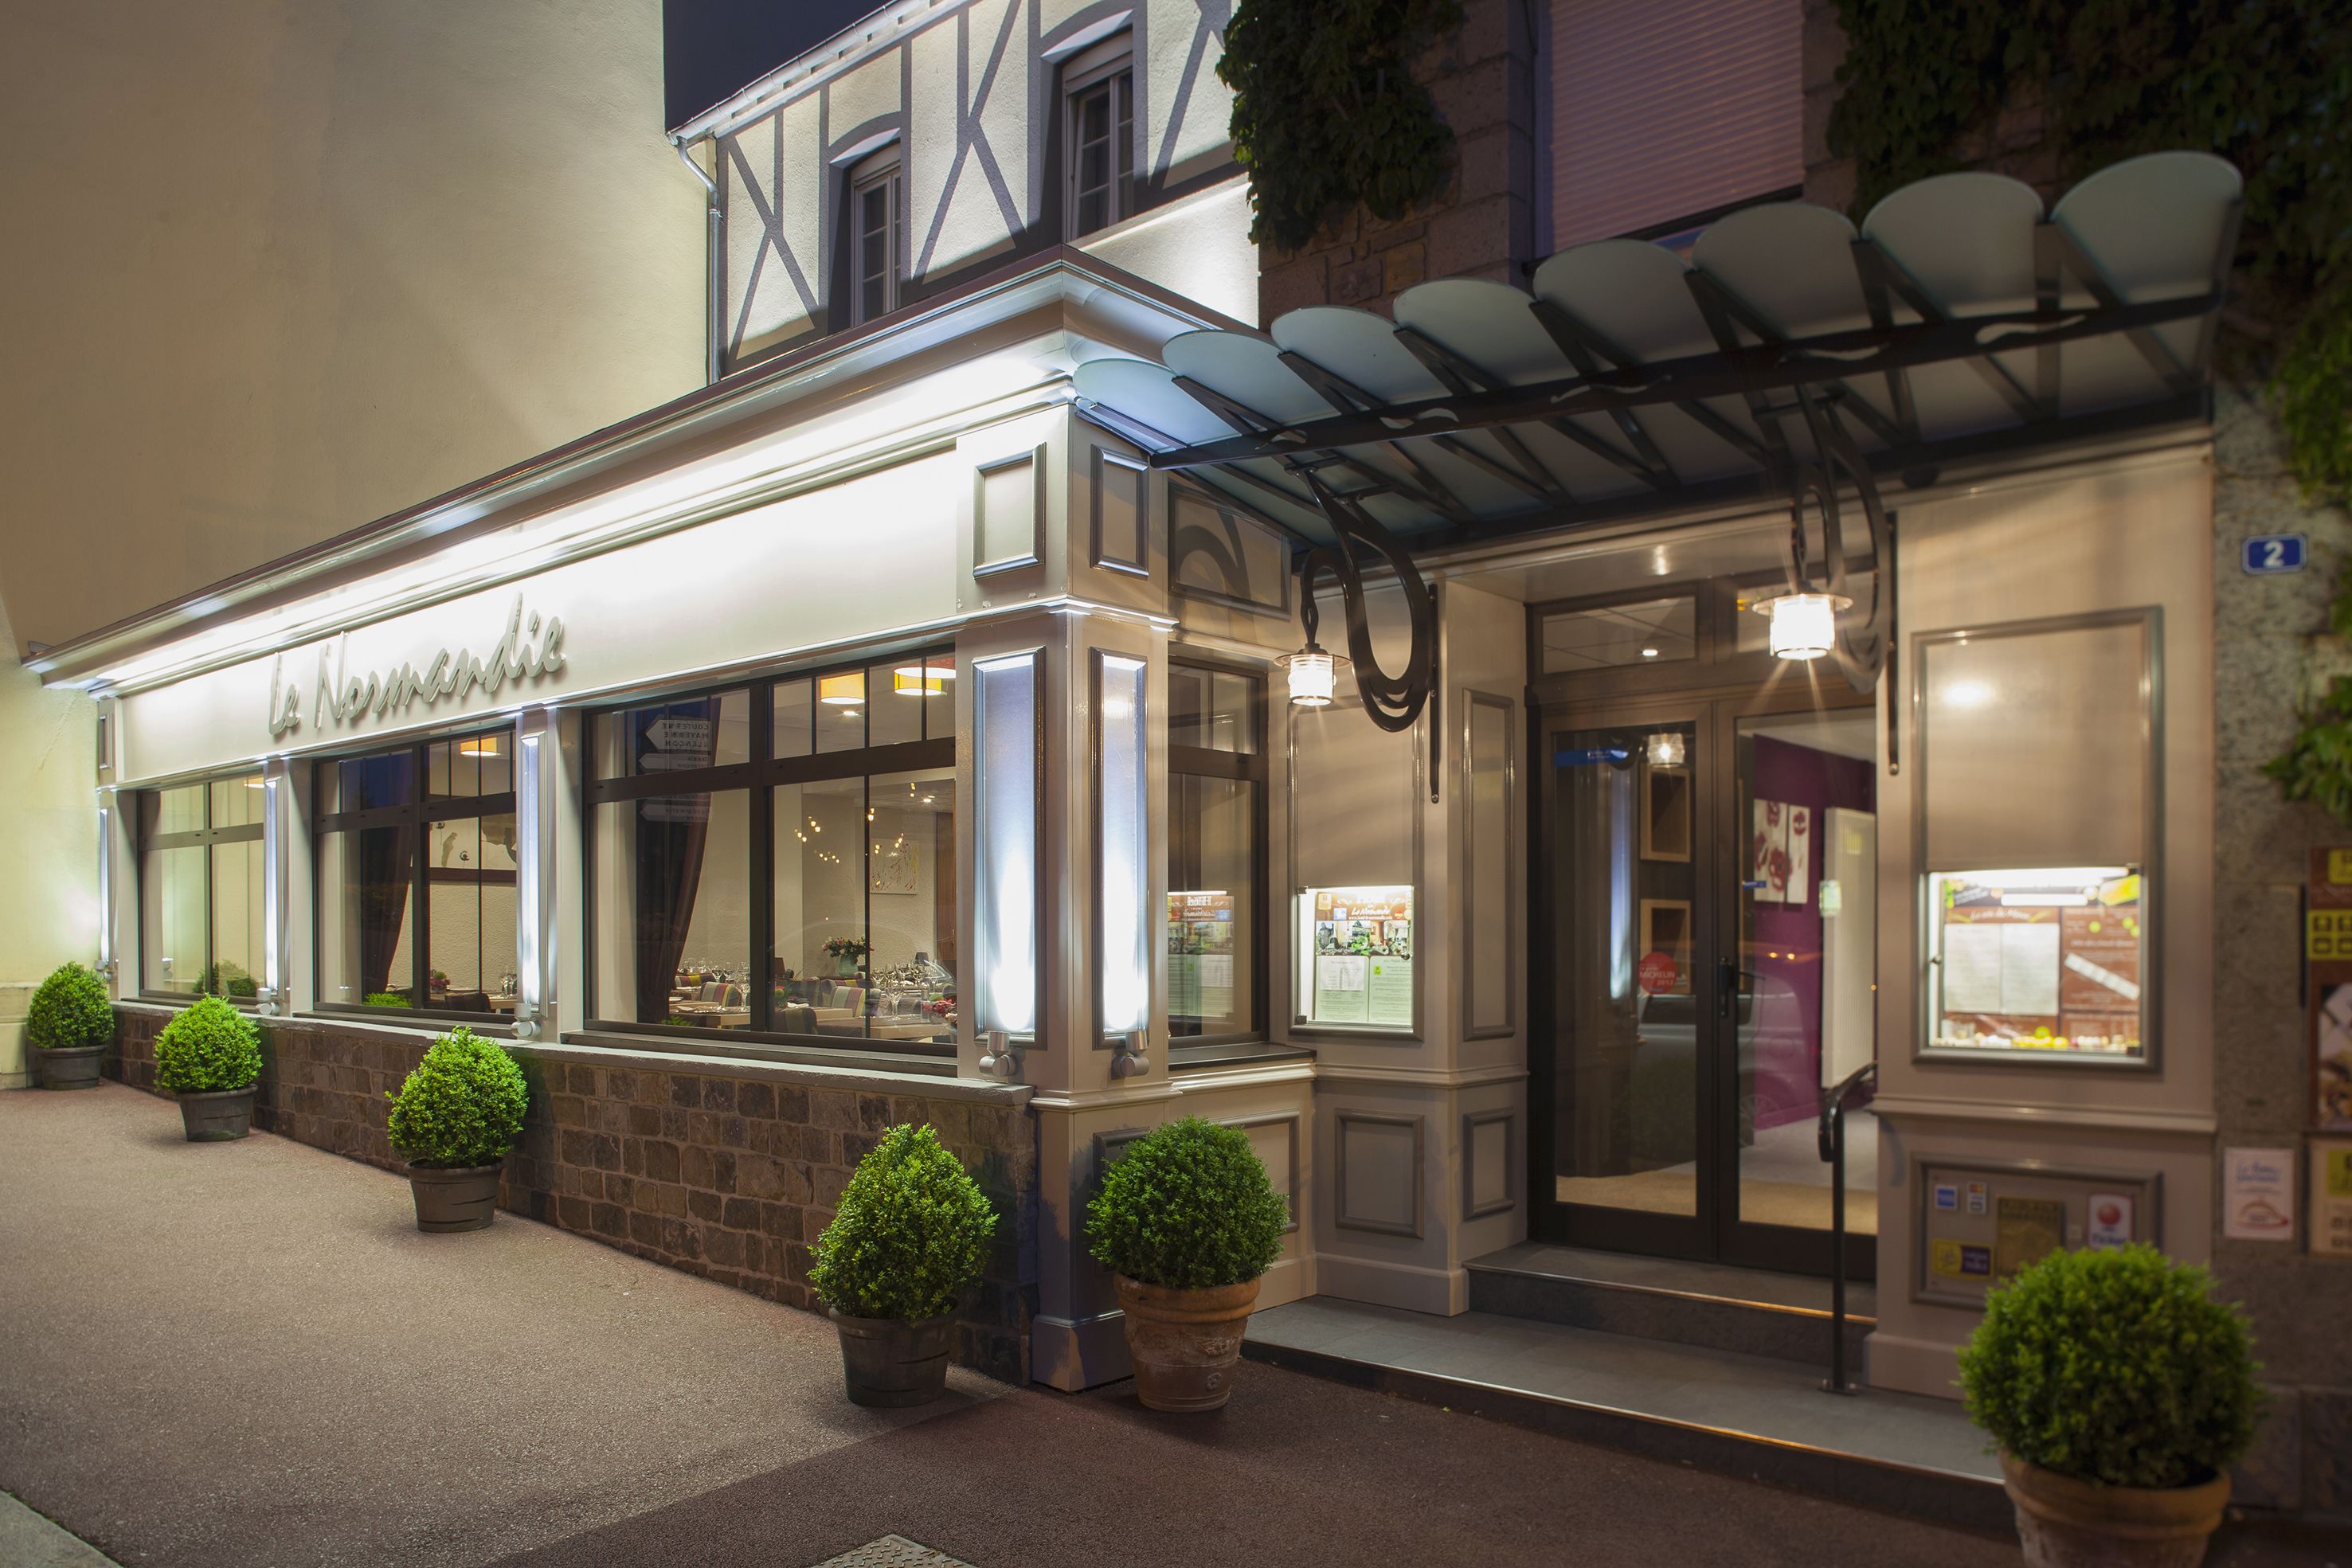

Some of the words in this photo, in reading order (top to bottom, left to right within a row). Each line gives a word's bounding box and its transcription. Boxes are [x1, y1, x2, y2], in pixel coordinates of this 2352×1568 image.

[2263, 539, 2285, 568] 2
[268, 651, 299, 735] Le
[315, 591, 567, 728] Normandie
